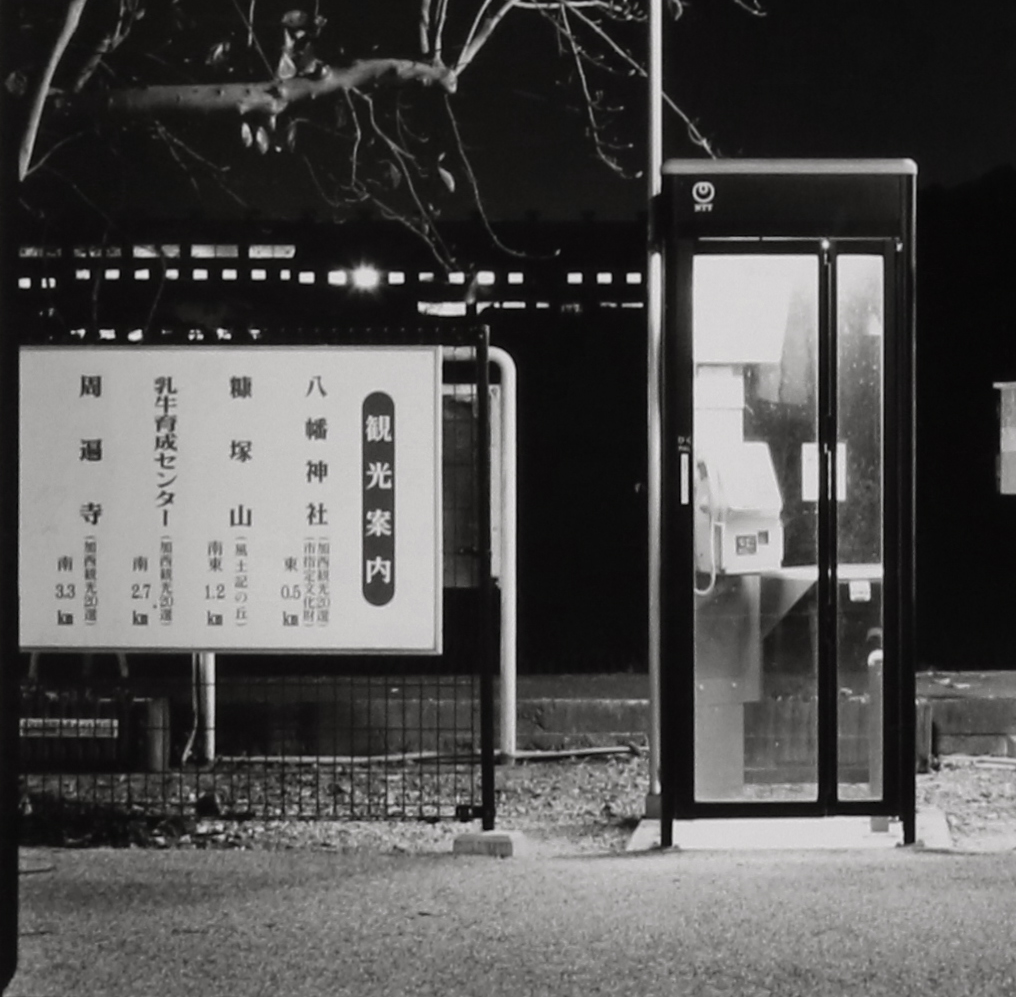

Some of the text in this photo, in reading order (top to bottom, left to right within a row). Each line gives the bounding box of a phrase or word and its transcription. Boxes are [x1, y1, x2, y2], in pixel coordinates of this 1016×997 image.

[694, 203, 714, 212] NTT
[154, 376, 178, 527] 乳牛育成センター
[229, 376, 253, 527] 糠塚山
[305, 375, 328, 526] 八幡神社
[365, 414, 393, 585] 観光案内
[283, 556, 299, 572] 東
[55, 583, 76, 600] 3.3
[131, 583, 151, 600] 2.7
[205, 583, 226, 600] 1.2
[280, 584, 302, 600] 0.5
